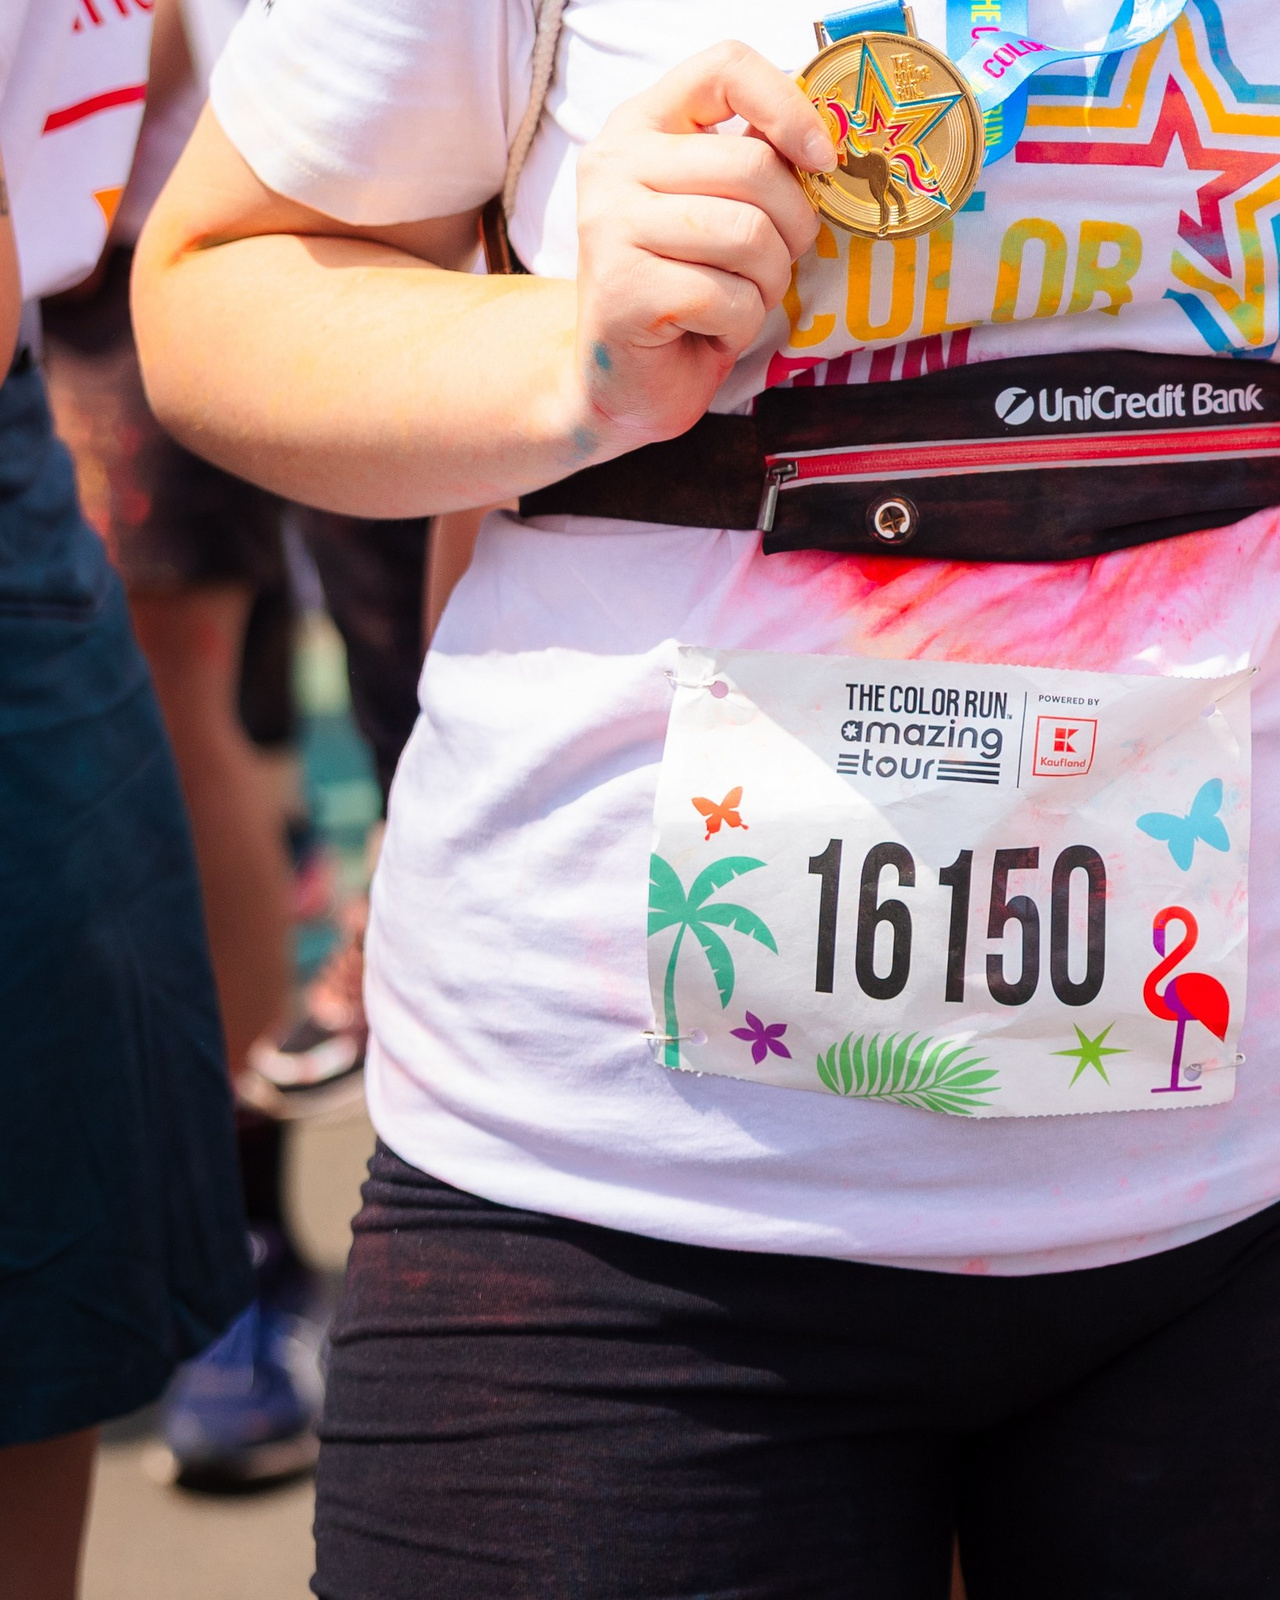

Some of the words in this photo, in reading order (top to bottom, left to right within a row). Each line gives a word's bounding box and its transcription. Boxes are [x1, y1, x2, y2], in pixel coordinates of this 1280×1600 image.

[1039, 384, 1186, 422] UniCredit
[1193, 383, 1264, 415] Bank
[846, 683, 885, 712] THE
[889, 685, 960, 717] COLOR
[964, 691, 1008, 719] RUN
[1038, 694, 1085, 705] POWERED
[1087, 696, 1100, 706] BY
[841, 719, 1004, 760] amazing
[862, 749, 936, 780] tour
[1040, 756, 1086, 769] Kaufland
[808, 838, 1107, 1007] 16150
